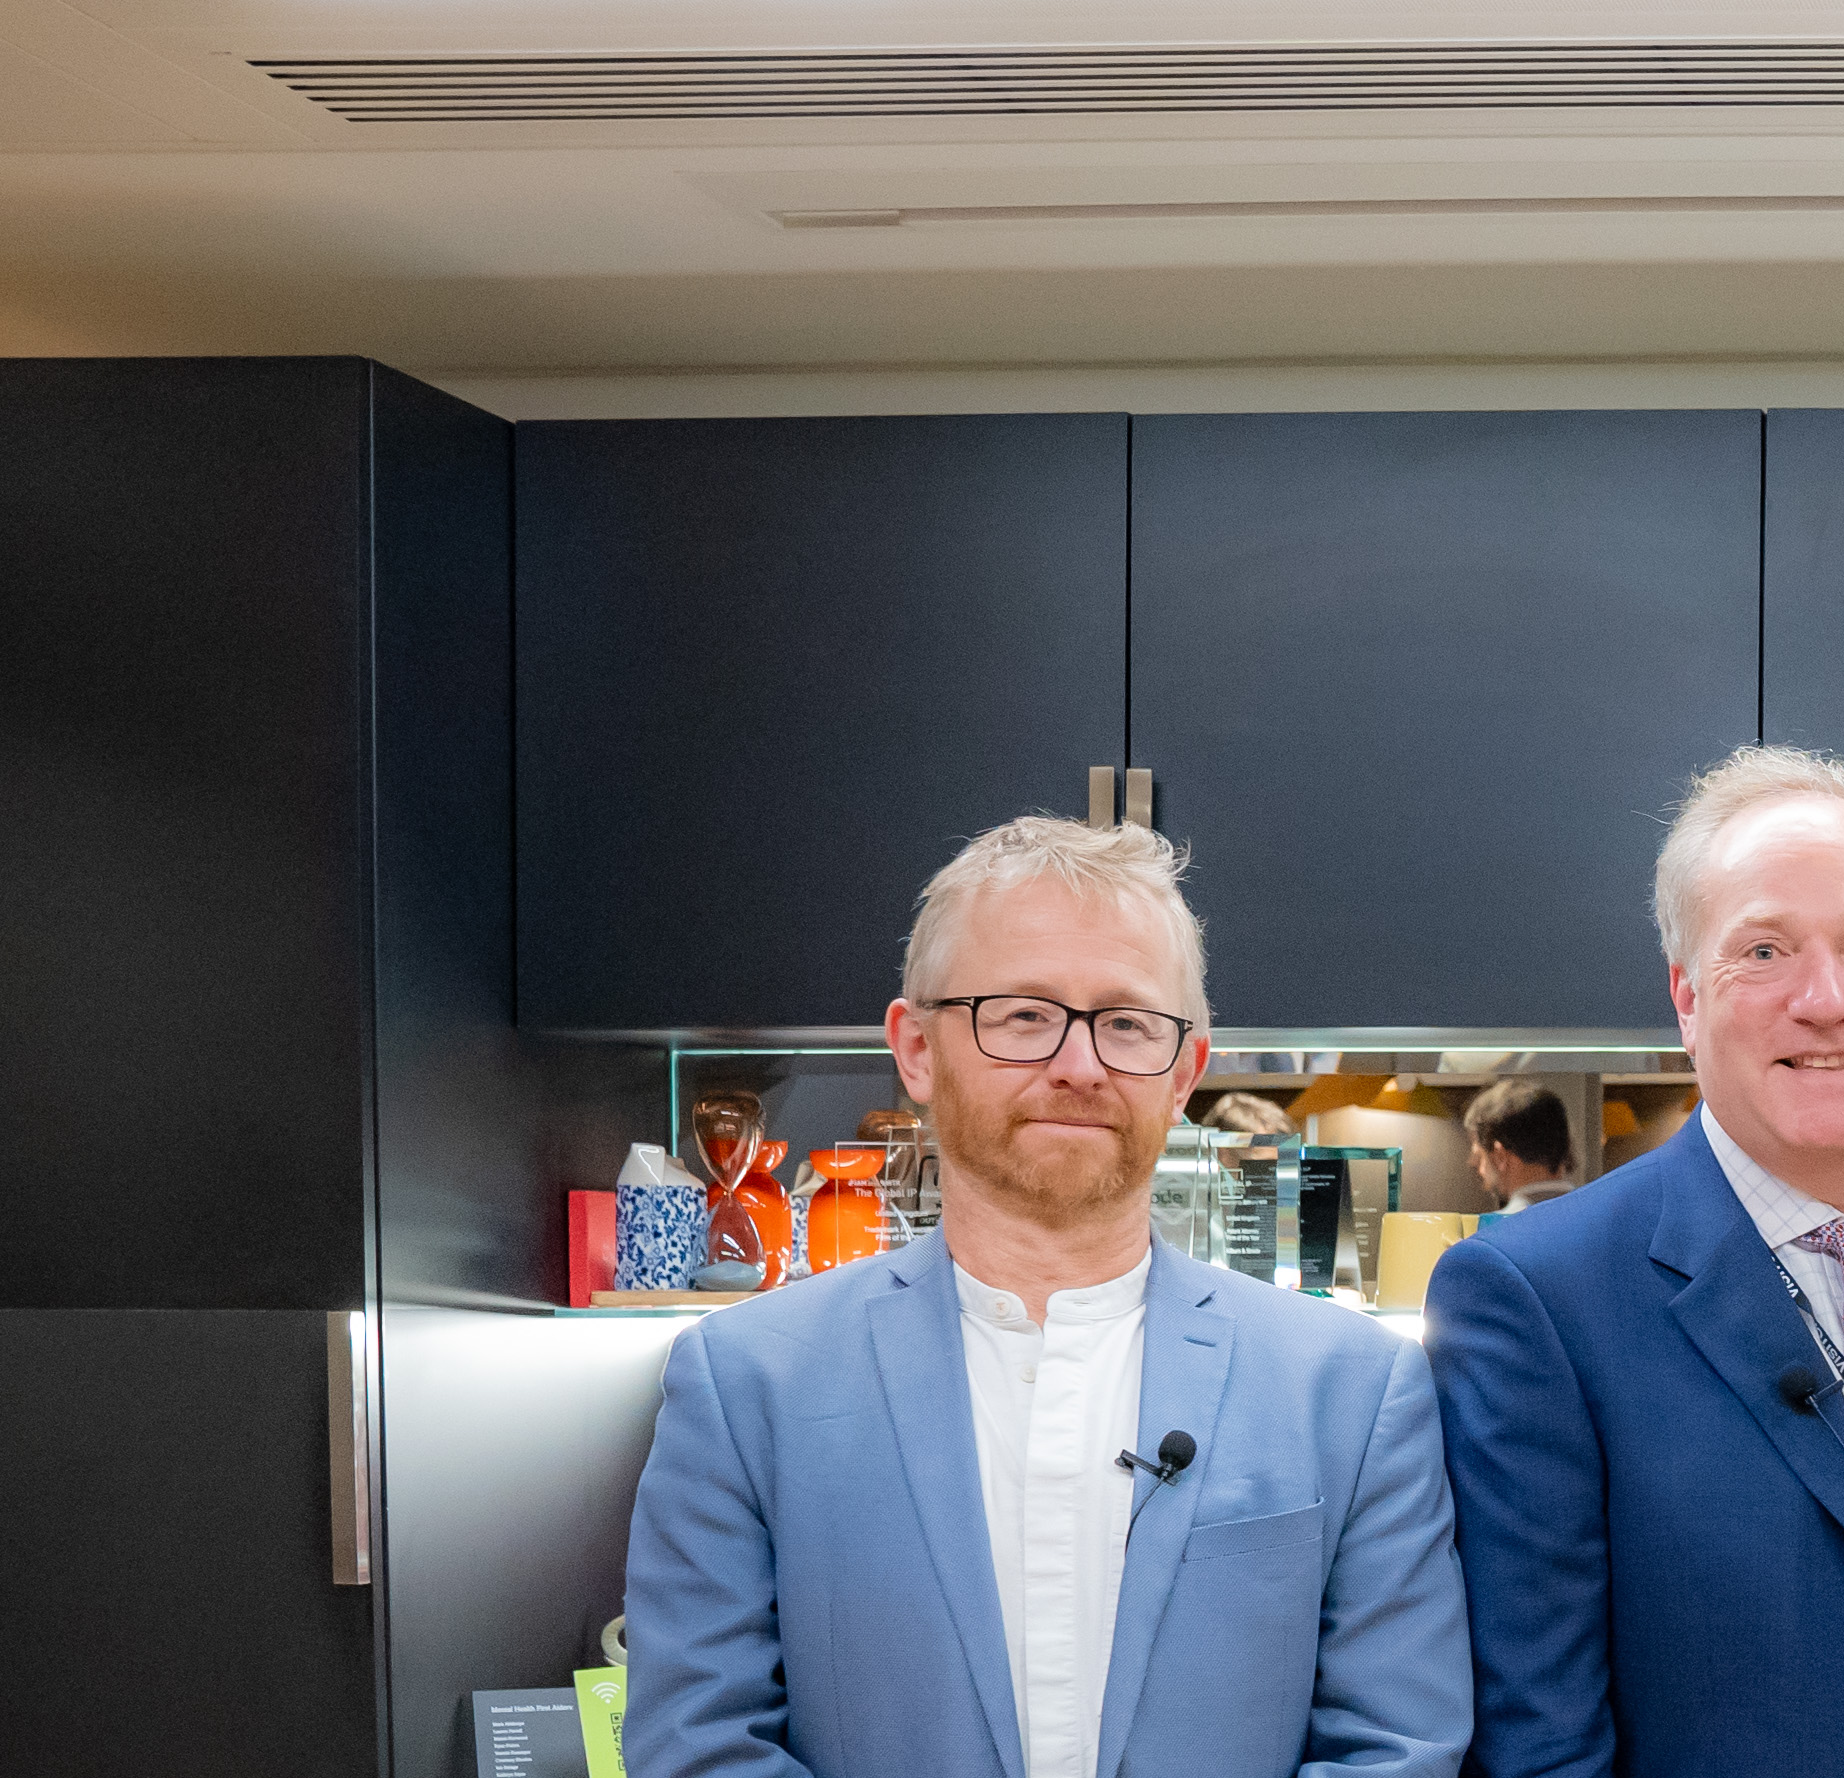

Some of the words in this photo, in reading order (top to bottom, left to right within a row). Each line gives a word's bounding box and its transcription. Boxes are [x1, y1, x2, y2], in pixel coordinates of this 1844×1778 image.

[855, 1188, 873, 1197] The
[874, 1188, 905, 1197] Global
[907, 1188, 917, 1197] IP
